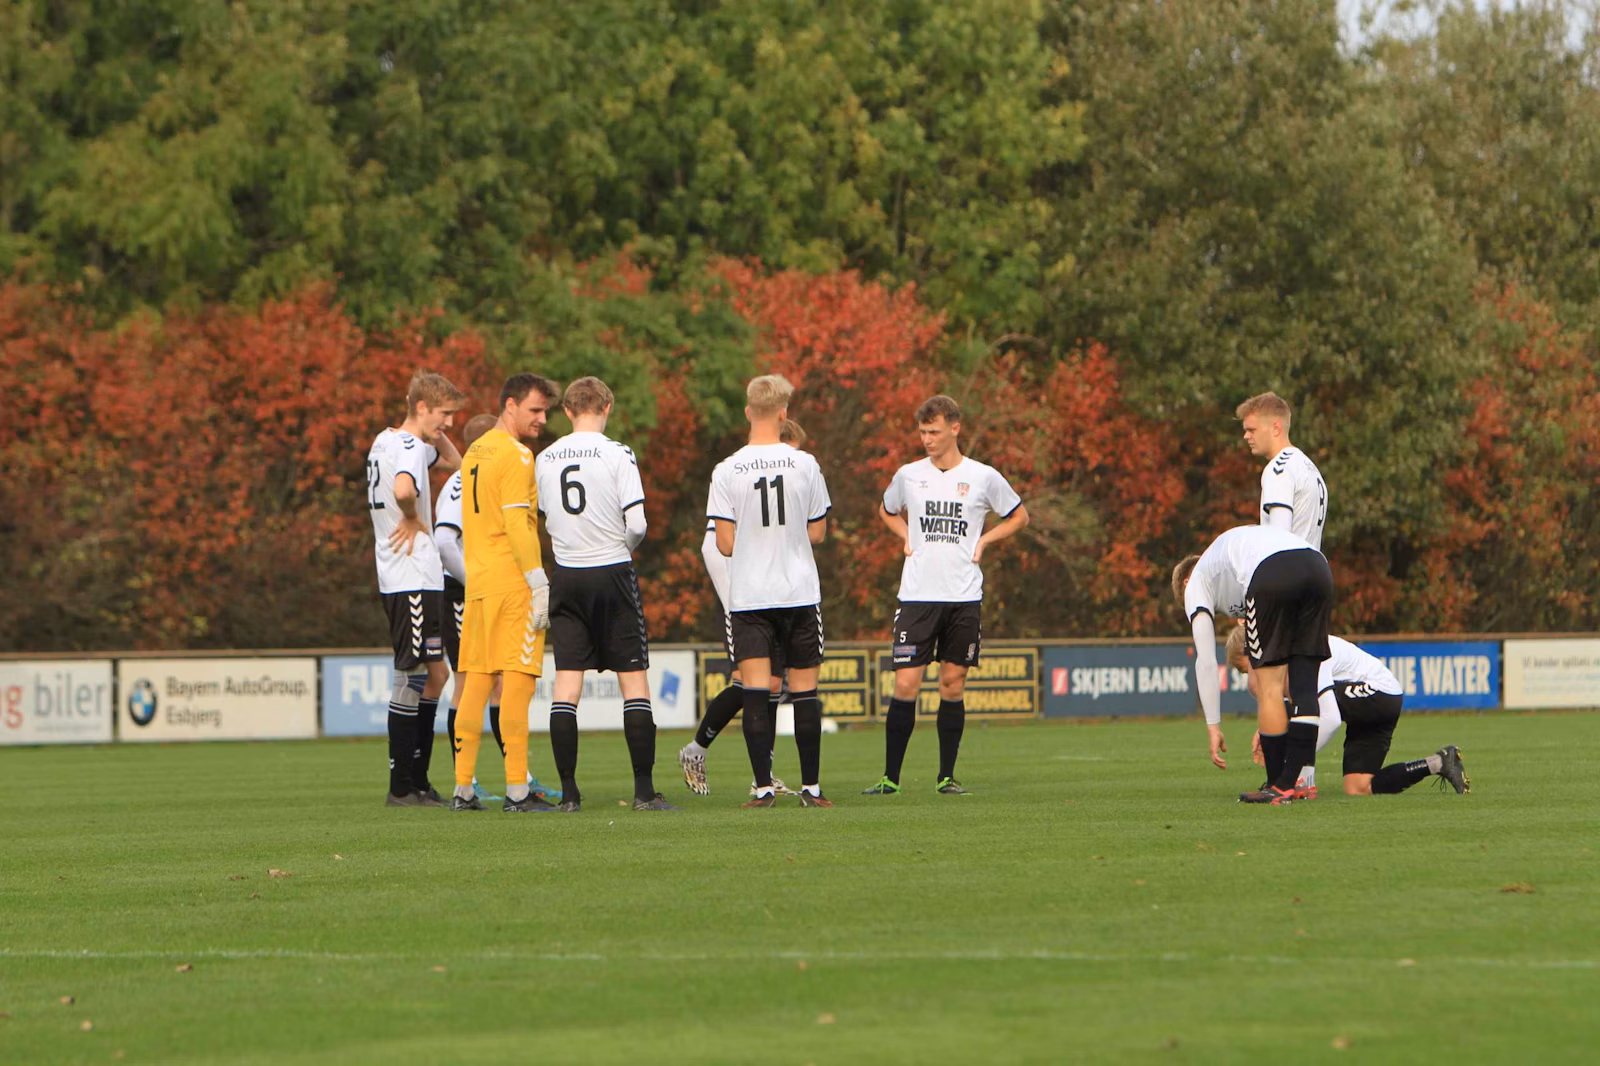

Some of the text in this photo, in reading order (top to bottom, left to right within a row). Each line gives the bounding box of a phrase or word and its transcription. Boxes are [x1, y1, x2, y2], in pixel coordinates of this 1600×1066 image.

[545, 447, 602, 463] Sydbank
[734, 457, 796, 475] Sydbank
[470, 463, 480, 514] 1
[560, 464, 586, 515] 6
[754, 474, 786, 527] 11
[925, 500, 963, 518] BLUE
[919, 516, 968, 537] WATER
[925, 534, 960, 544] SHIPPING
[899, 631, 907, 643] 5
[1072, 666, 1188, 699] SKJERN BANK
[1421, 655, 1491, 695] WATER
[34, 672, 106, 717] biler
[165, 676, 221, 701] Bayern
[165, 705, 222, 728] Esbjerg
